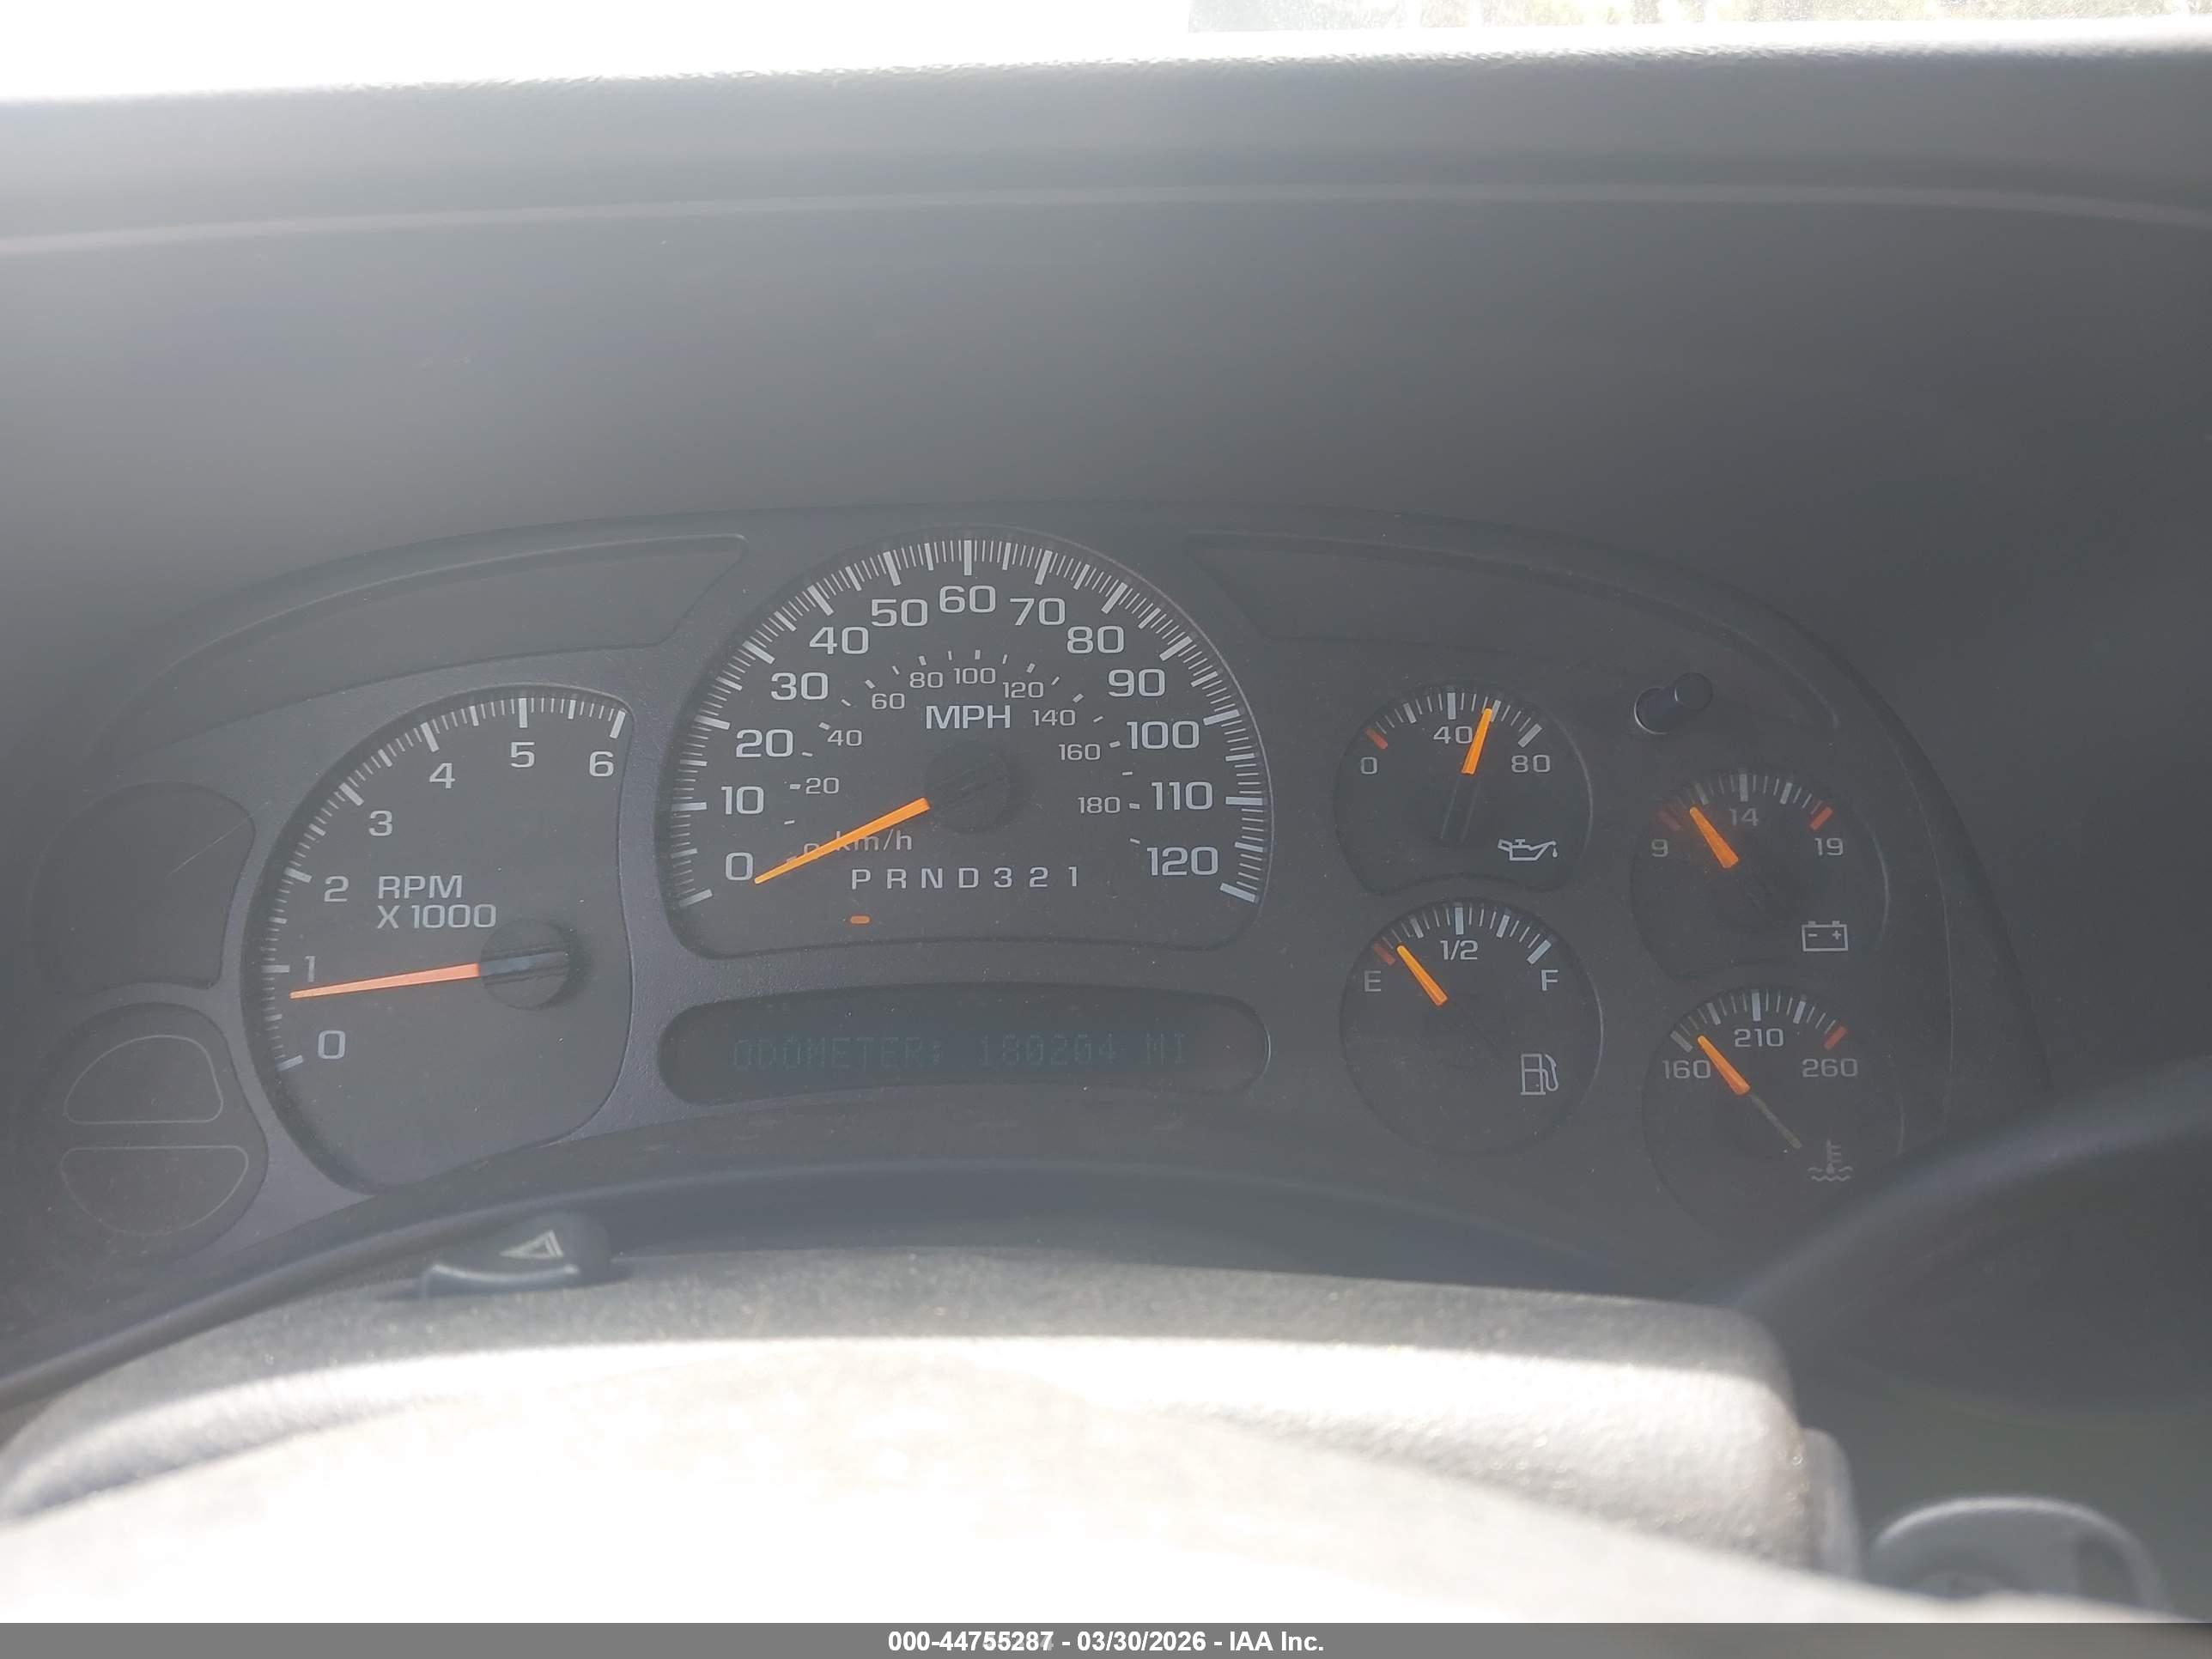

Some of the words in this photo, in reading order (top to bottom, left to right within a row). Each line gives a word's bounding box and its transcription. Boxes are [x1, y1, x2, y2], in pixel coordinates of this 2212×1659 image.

[939, 585, 997, 613] 60
[870, 599, 928, 627] 50
[1009, 598, 1066, 626] 70
[809, 626, 869, 654] 40
[1066, 626, 1125, 654] 80
[770, 672, 829, 701] 30
[908, 672, 944, 689] 80
[953, 667, 996, 684] 100
[1108, 669, 1166, 697] 90
[871, 693, 906, 710] 60
[1003, 681, 1044, 699] 120
[925, 705, 1012, 729] MPH
[1031, 709, 1078, 727] 140
[735, 729, 794, 758] 20
[826, 729, 863, 747] 40
[1127, 721, 1200, 750] 100
[1432, 726, 1474, 744] 40
[510, 741, 536, 769] 5
[588, 750, 615, 777] 6
[1058, 744, 1101, 761] 160
[1510, 755, 1552, 774] 80
[429, 762, 455, 788] 4
[1359, 757, 1378, 775] 0
[805, 776, 840, 794] 20
[1151, 781, 1214, 811] 110
[721, 786, 765, 815] 10
[1078, 796, 1121, 814] 180
[368, 810, 393, 836] 3
[1729, 808, 1759, 827] 14
[1650, 838, 1669, 858] 9
[1814, 837, 1844, 857] 19
[725, 852, 754, 881] 0
[1146, 846, 1220, 876] 120
[323, 876, 349, 902] 2
[377, 875, 465, 900] RPM
[377, 905, 398, 929] X
[412, 903, 497, 929] 1000
[1440, 939, 1479, 961] 1/2
[303, 956, 316, 982] 1
[1364, 970, 1382, 993] E
[1540, 969, 1559, 991] F
[317, 1030, 346, 1060] 0
[1143, 1030, 1188, 1066] MI
[1734, 1028, 1784, 1048] 210
[1662, 1059, 1711, 1079] 160
[1802, 1058, 1859, 1079] 260
